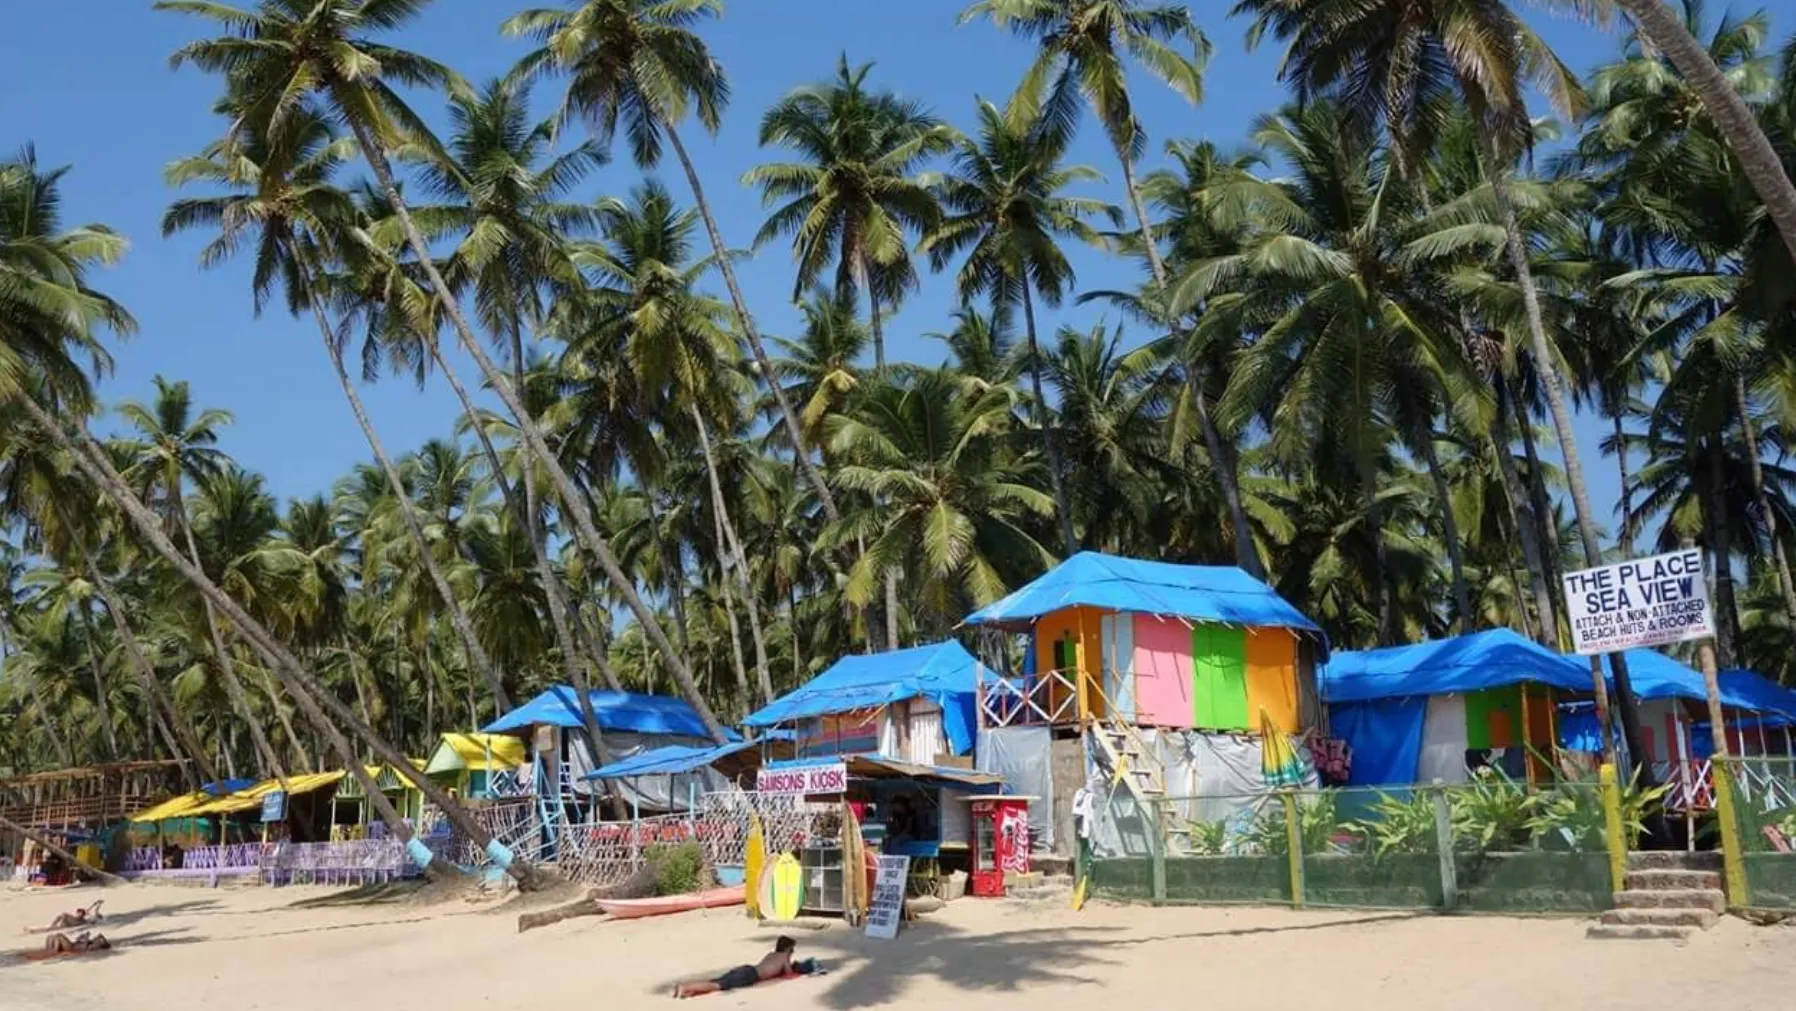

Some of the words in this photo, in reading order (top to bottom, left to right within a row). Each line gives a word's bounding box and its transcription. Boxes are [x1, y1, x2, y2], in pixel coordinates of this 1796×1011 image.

[1566, 569, 1612, 594] THE
[1619, 552, 1700, 585] PLACE
[1586, 588, 1631, 614] SEA
[1639, 576, 1693, 605] VIEW
[1575, 615, 1613, 630] ATTACH
[1616, 613, 1624, 623] &
[1582, 627, 1616, 641] BEACH
[1620, 621, 1645, 634] HUTS
[1647, 620, 1657, 631] &
[1659, 612, 1704, 629] ROOMS
[758, 772, 805, 792] SAMSONS
[810, 769, 845, 789] KIOSK
